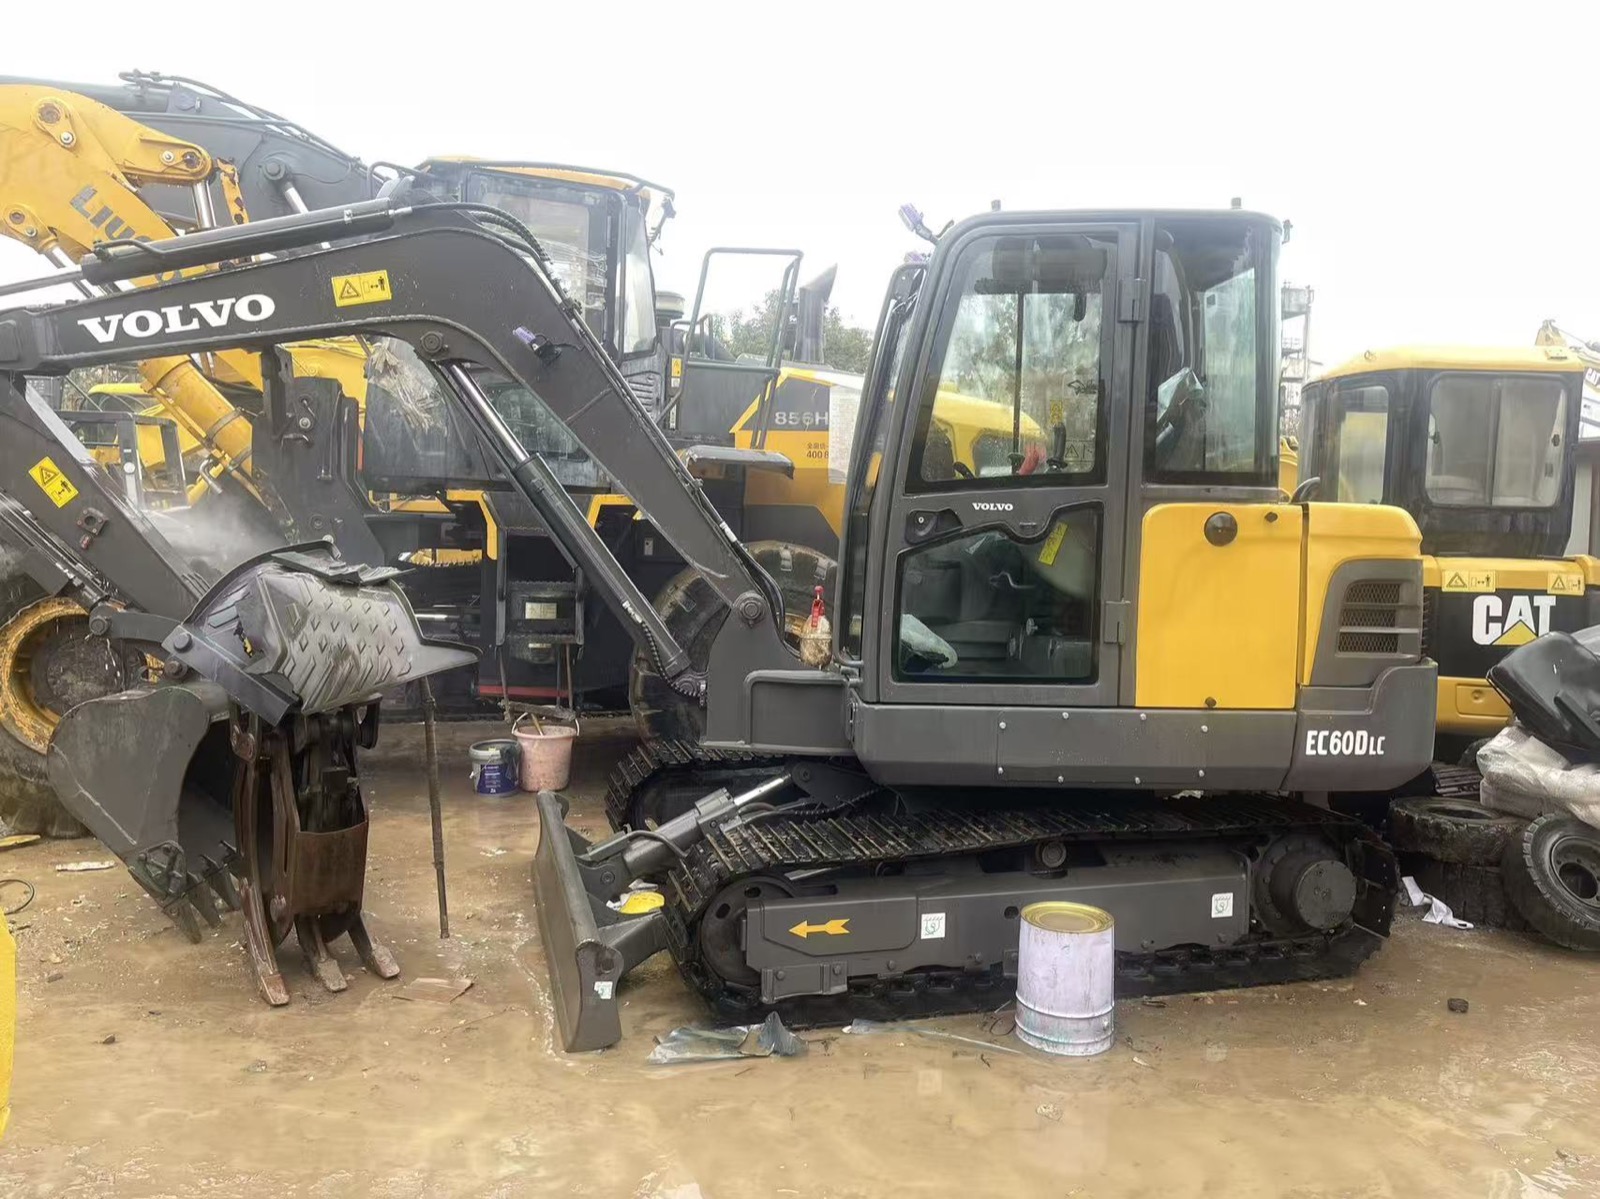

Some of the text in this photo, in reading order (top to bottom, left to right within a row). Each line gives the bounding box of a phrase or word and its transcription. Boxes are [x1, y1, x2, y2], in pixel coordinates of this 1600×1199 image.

[77, 294, 276, 343] VOLVO
[775, 411, 829, 426] 856H
[806, 450, 823, 459] 400
[972, 502, 1014, 511] VOLVO
[1472, 595, 1556, 645] CAT
